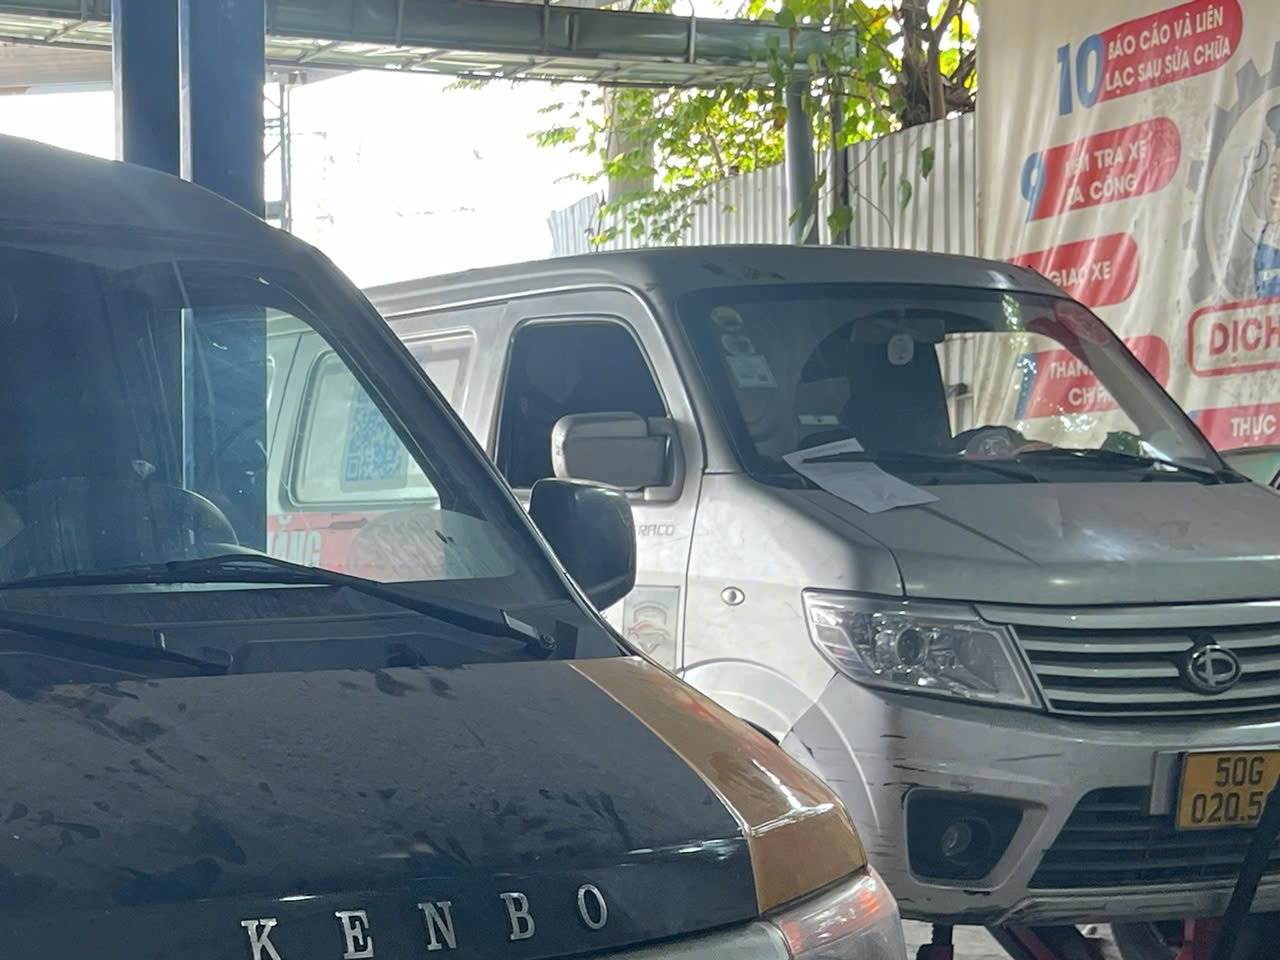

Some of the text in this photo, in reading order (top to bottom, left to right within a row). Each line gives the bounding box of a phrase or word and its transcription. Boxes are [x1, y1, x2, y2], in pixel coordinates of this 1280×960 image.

[1057, 4, 1223, 116] 10 BÁO CÁO VÀ LIÊN
[1106, 67, 1135, 94] LẠC
[1138, 59, 1162, 82] SAU
[1094, 149, 1123, 169] TRA
[1129, 140, 1148, 161] XE
[1091, 260, 1111, 280] XE
[1048, 359, 1093, 380] THAN
[1231, 414, 1276, 441] THỰC
[267, 515, 321, 568] ĂNG
[1215, 756, 1264, 787] 50G
[1190, 791, 1264, 823] 020.5
